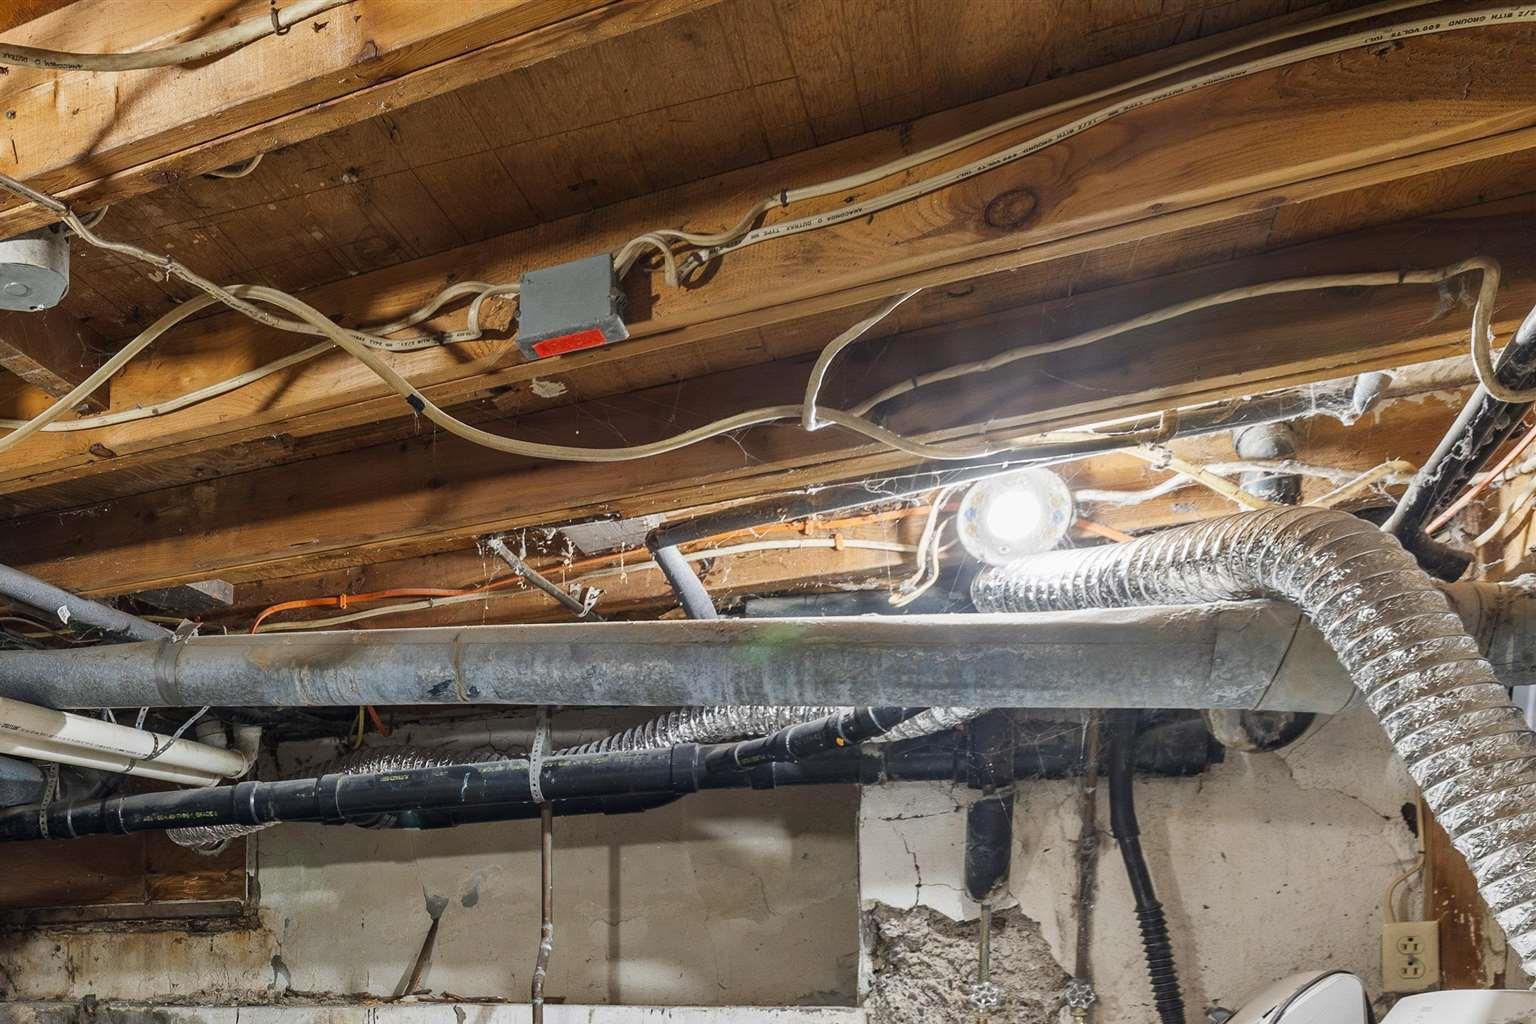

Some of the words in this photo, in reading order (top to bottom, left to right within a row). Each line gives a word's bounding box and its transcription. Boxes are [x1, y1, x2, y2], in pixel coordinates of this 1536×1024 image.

[1447, 12, 1486, 27] GROUND
[1421, 22, 1441, 32] 600
[763, 226, 780, 237] TYPE
